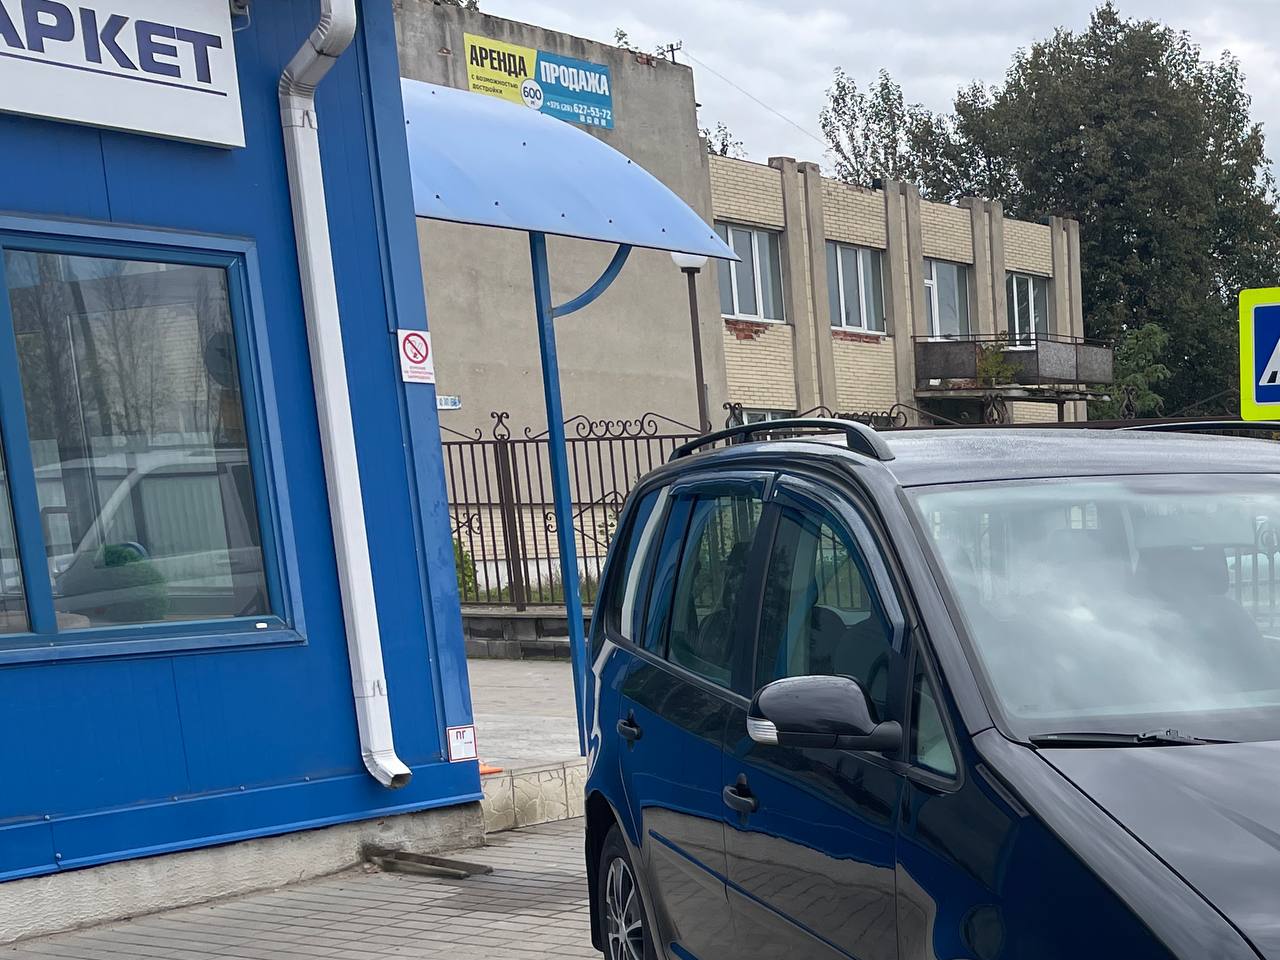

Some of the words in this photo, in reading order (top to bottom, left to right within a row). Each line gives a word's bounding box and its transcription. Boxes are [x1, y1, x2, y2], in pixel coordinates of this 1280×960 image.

[470, 44, 528, 78] АРЕНДА
[539, 60, 610, 96] ПРОДАЖА
[523, 86, 542, 101] 600
[573, 103, 611, 120] 627-53-72
